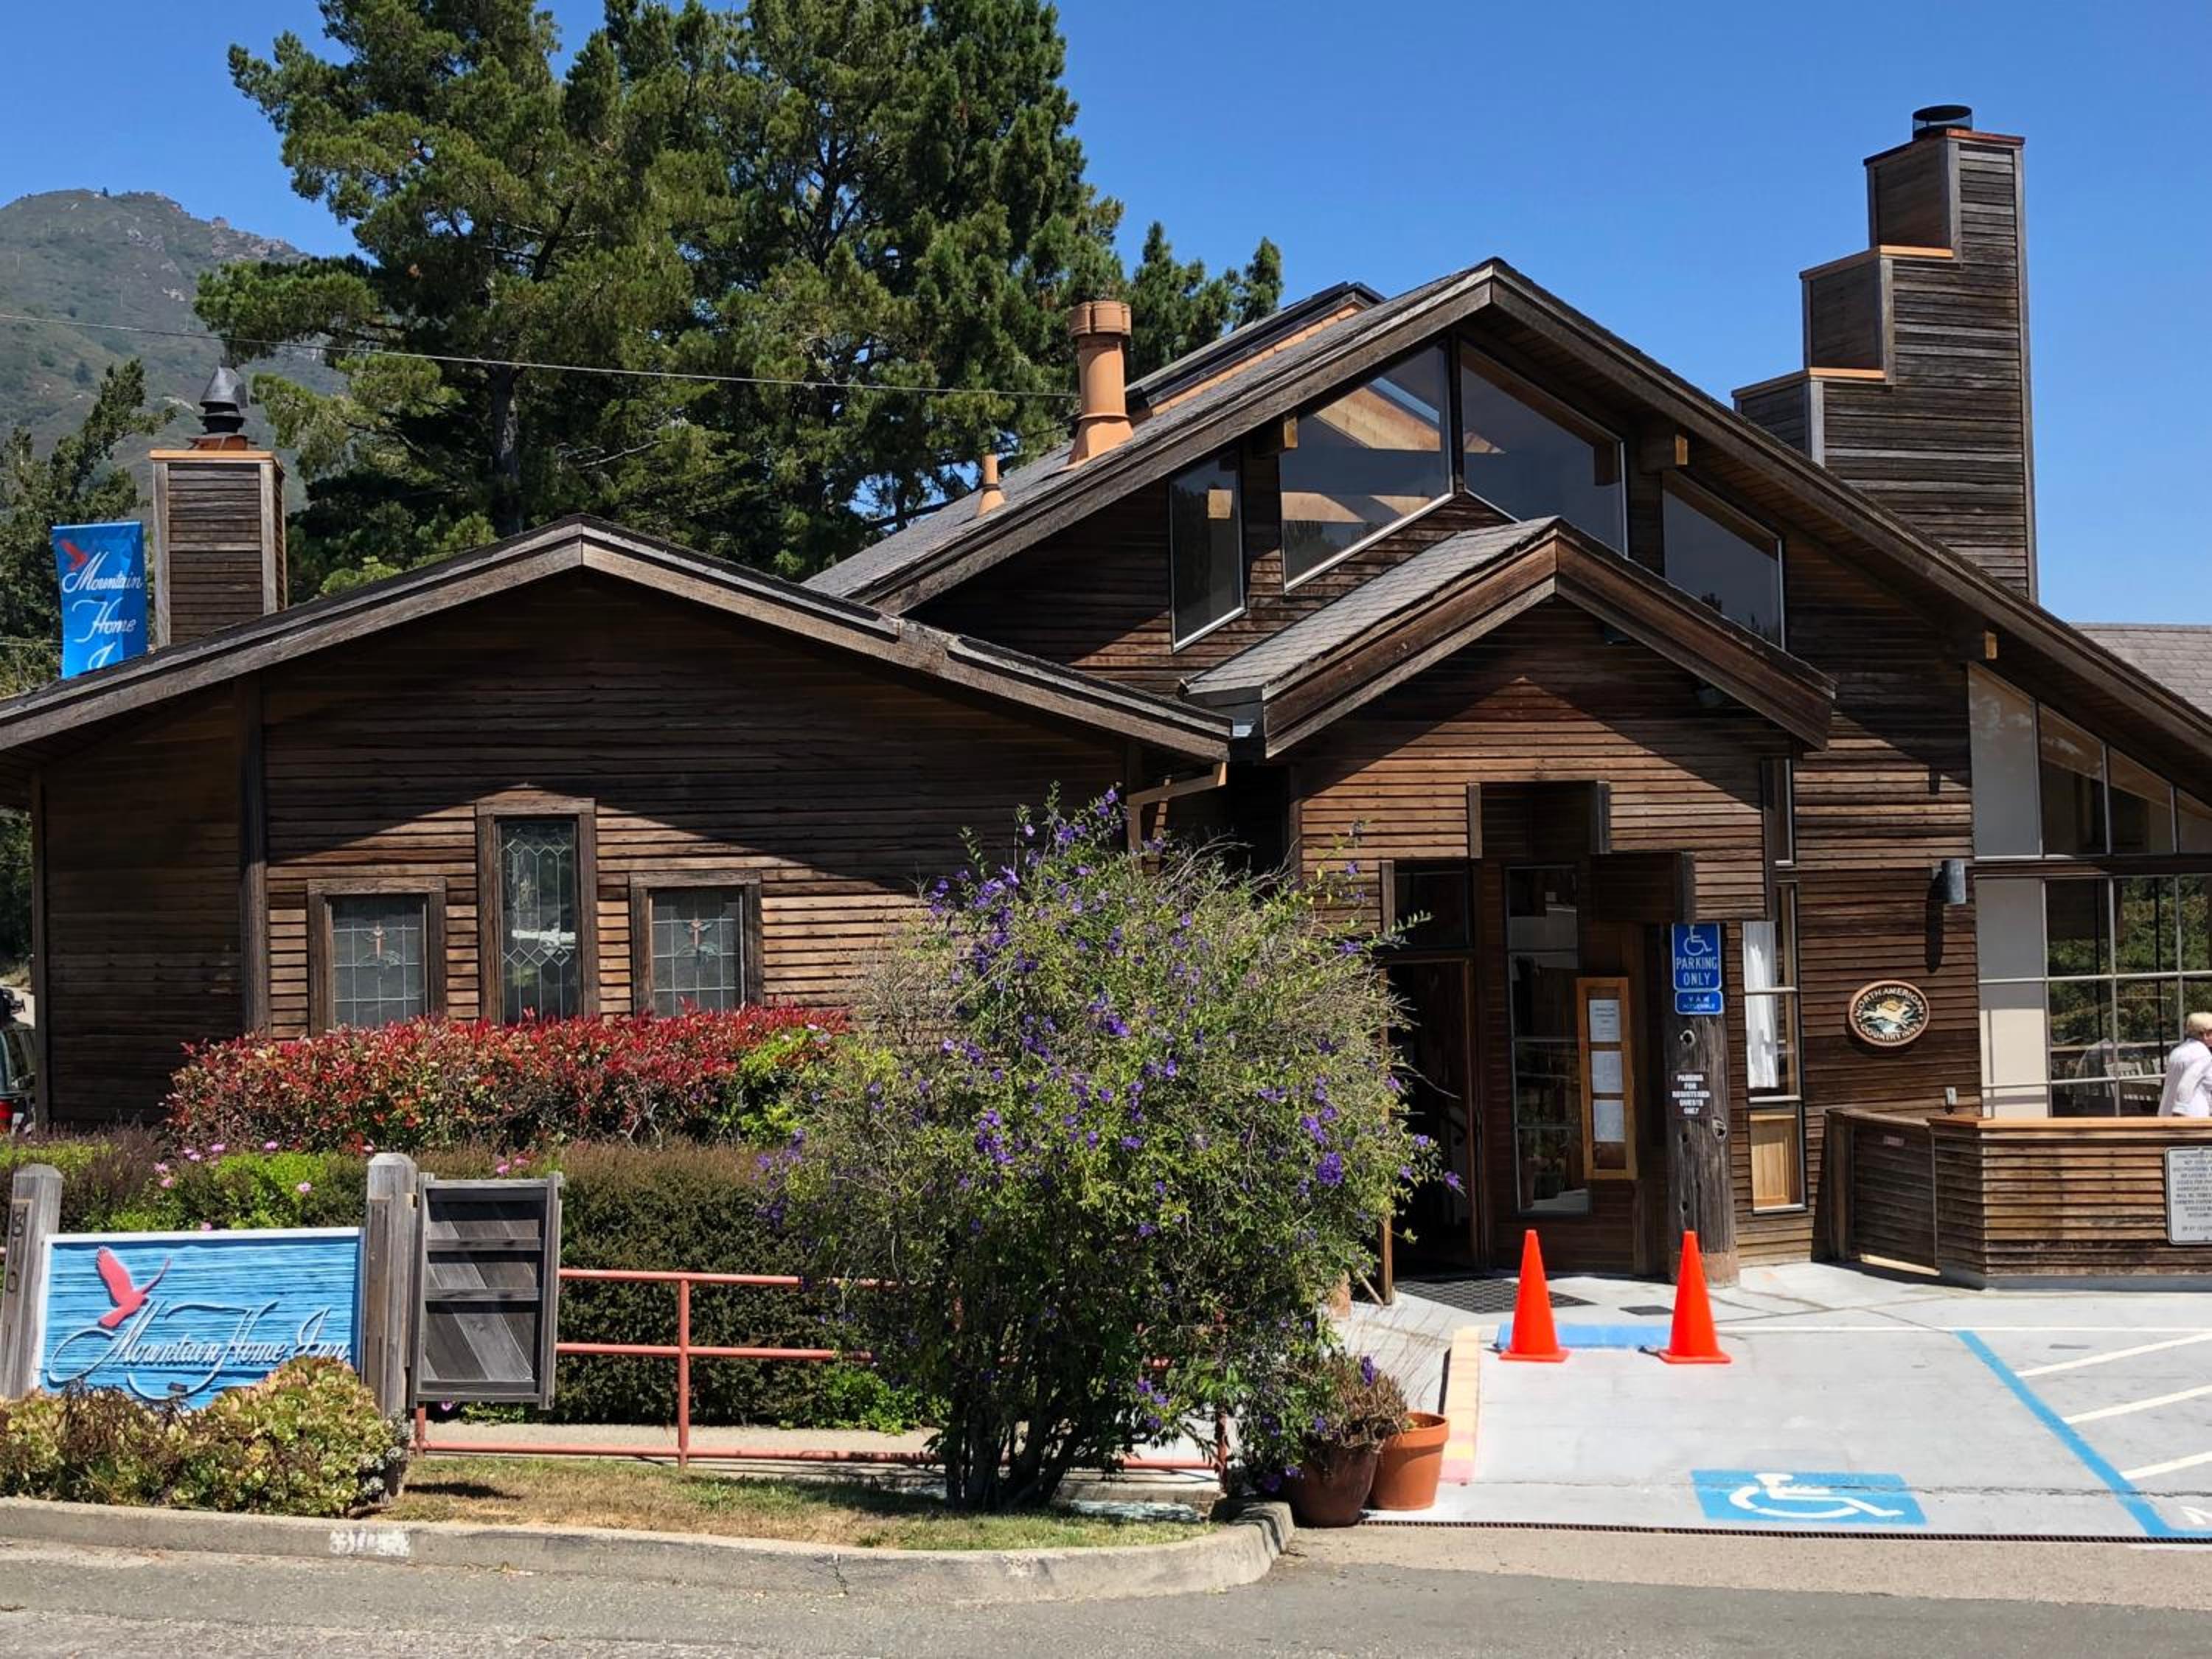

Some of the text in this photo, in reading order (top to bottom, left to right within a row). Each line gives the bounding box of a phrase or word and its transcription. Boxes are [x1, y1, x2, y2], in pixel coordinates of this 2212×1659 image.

[62, 552, 143, 593] Mountain
[72, 597, 137, 642] Home
[1676, 956, 1717, 970] PARKING
[1683, 972, 1711, 987] ONLY
[1855, 987, 1924, 1017] NORTH AMERICAN
[1860, 1024, 1901, 1041] COUNTRY
[1683, 1107, 1699, 1115] ONLY
[48, 1299, 351, 1401] Mountain Home Inn
